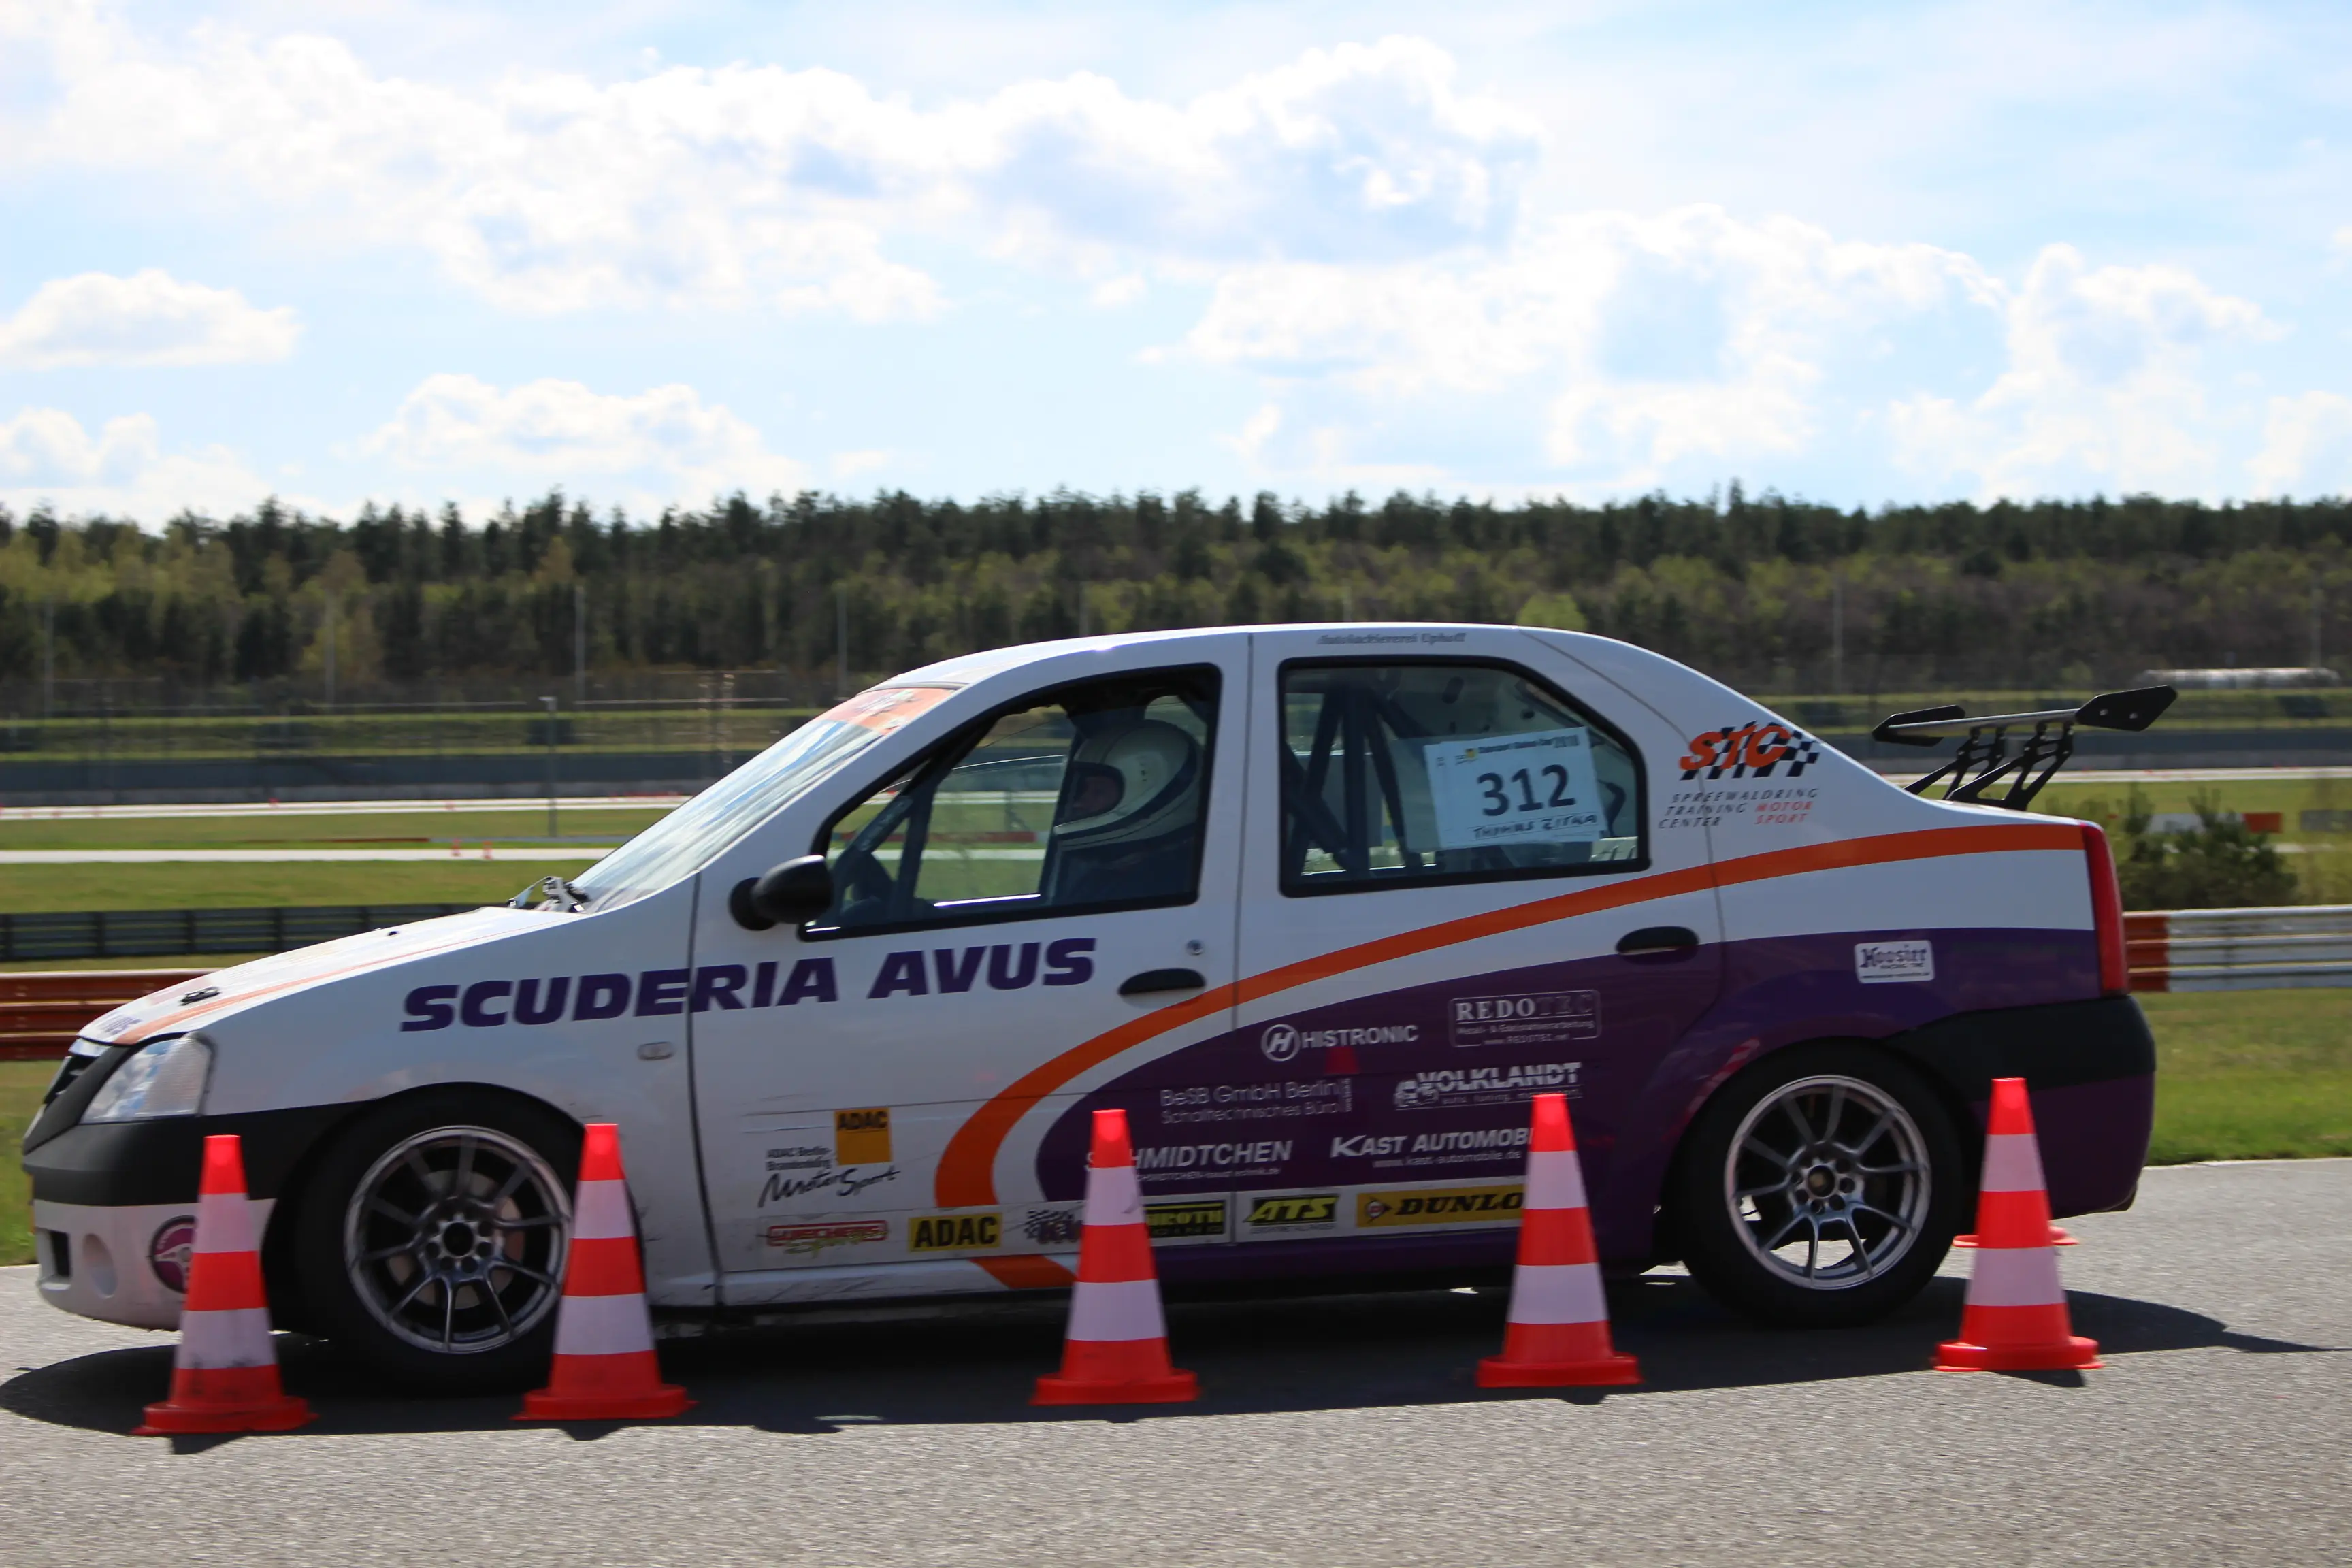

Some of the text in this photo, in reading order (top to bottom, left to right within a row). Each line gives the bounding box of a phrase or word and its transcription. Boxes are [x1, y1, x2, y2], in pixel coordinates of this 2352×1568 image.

[1679, 724, 1793, 770] STC
[1476, 764, 1575, 817] 312
[1671, 787, 1820, 804] SPREEWALDRING
[1658, 813, 1808, 829] CENTER SPORT
[1665, 800, 1814, 816] TRAINING MOTOR
[399, 938, 1097, 1032] SCUDERIA AVUS
[1455, 994, 1593, 1021] REDOTEC
[1301, 1024, 1420, 1049] HISTRONIC
[1416, 1062, 1583, 1092] VOLKLANDT
[1160, 1088, 1210, 1107] BeSB
[1213, 1082, 1282, 1102] GmbH
[1285, 1079, 1341, 1099] Berlin
[838, 1110, 888, 1130] ADAC
[1083, 1140, 1293, 1172] HMIDTCHEN
[1330, 1127, 1534, 1158] KAST AUTOMOBI
[1243, 1196, 1338, 1222] ATS
[1394, 1192, 1524, 1215] DUNLO
[914, 1215, 998, 1248] ADAC
